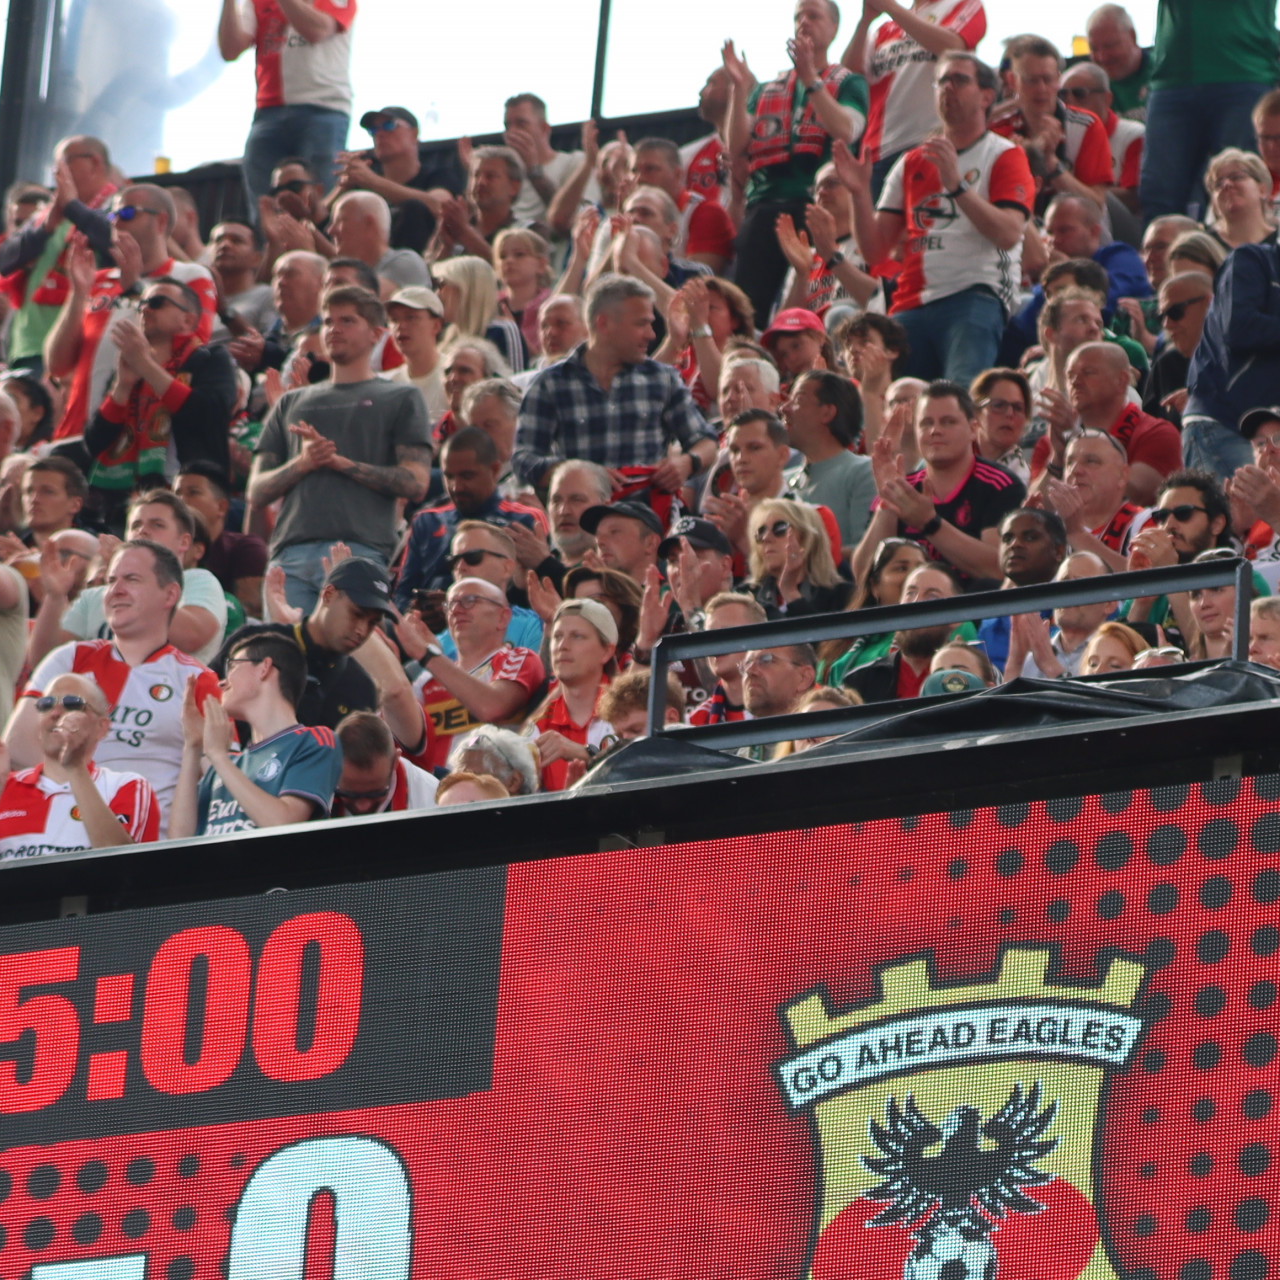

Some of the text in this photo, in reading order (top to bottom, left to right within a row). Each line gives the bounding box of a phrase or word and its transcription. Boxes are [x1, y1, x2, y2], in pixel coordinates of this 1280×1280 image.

[793, 1017, 1125, 1095] GO AHEAD EAGLES
